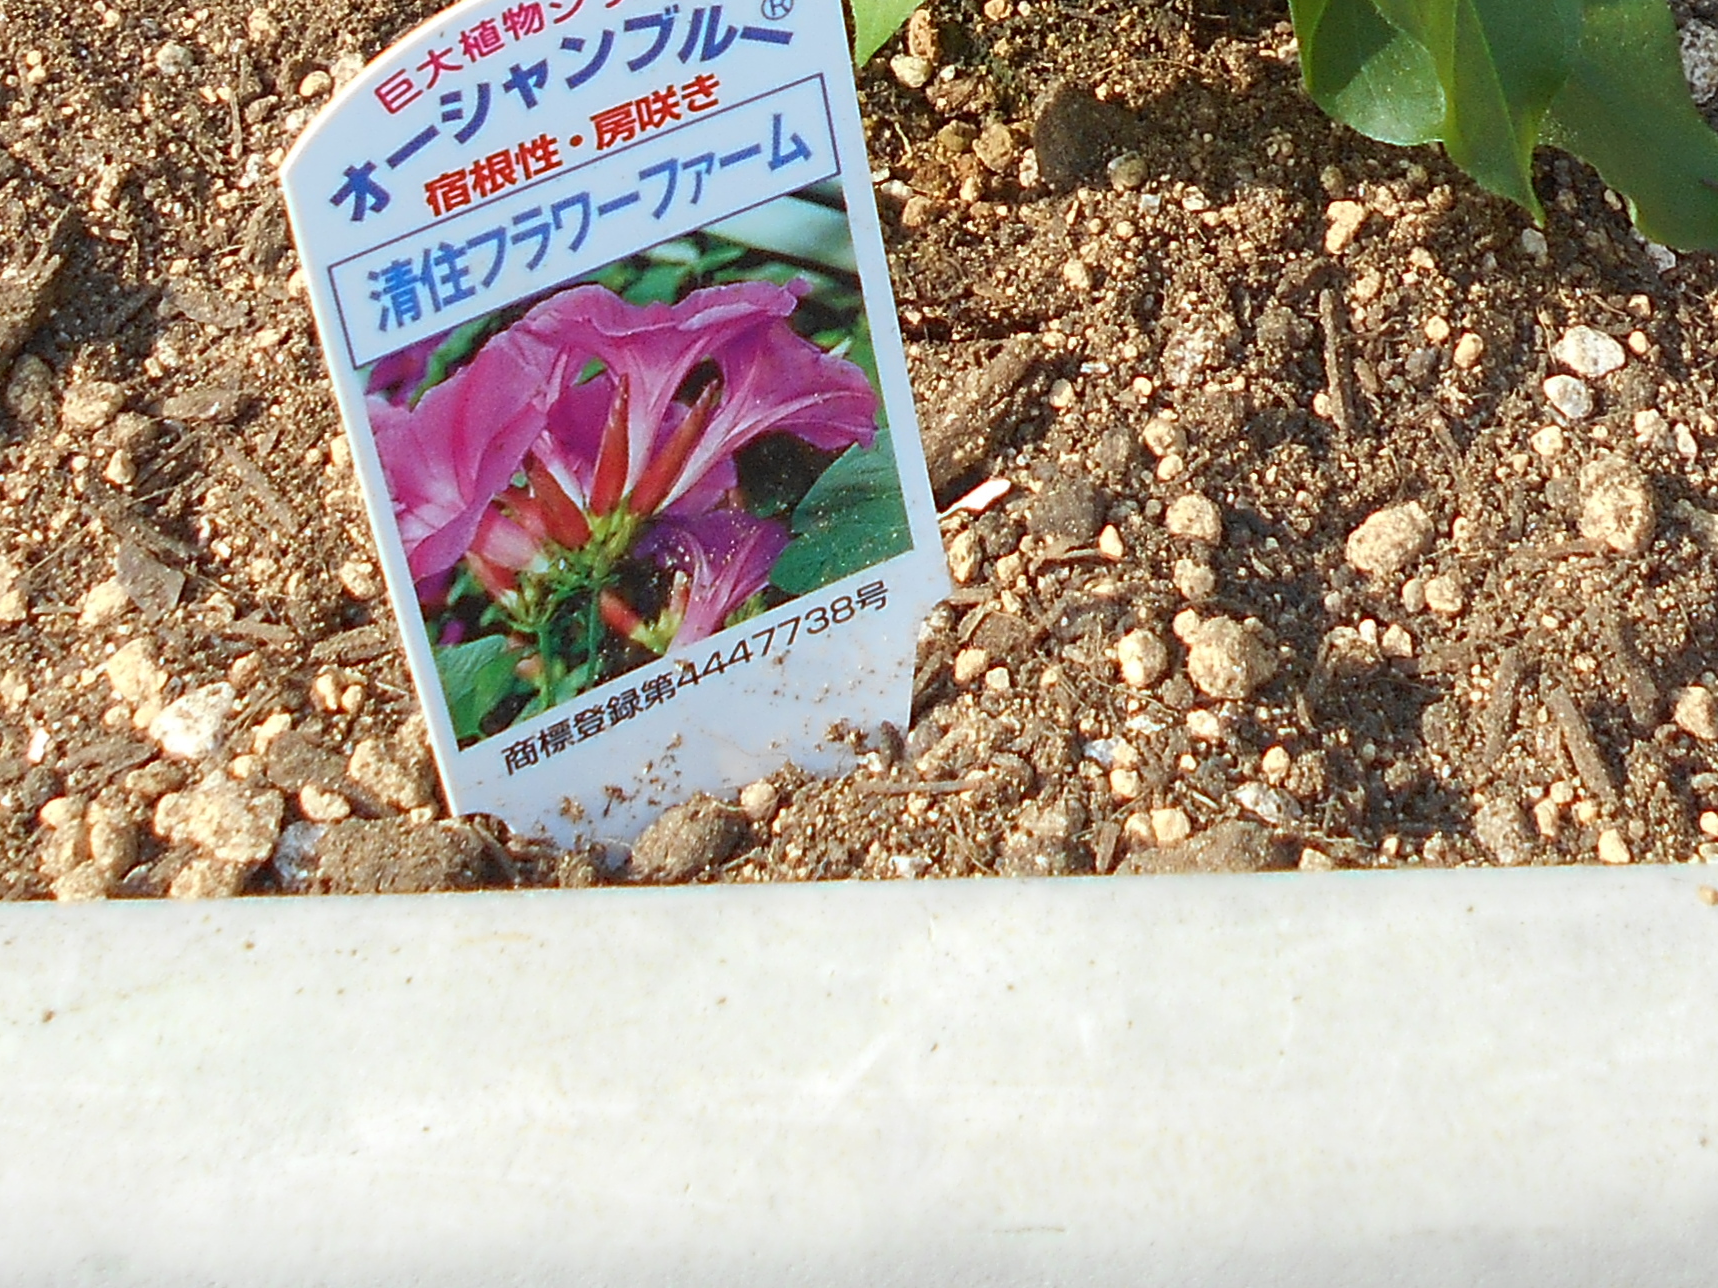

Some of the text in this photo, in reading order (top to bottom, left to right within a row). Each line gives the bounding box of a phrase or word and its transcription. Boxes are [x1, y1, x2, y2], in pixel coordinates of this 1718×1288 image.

[366, 111, 812, 334] 清住フラワーファーム
[423, 73, 721, 217] 宿根性・房咲き
[500, 579, 890, 776] 商標登録第4447738号
